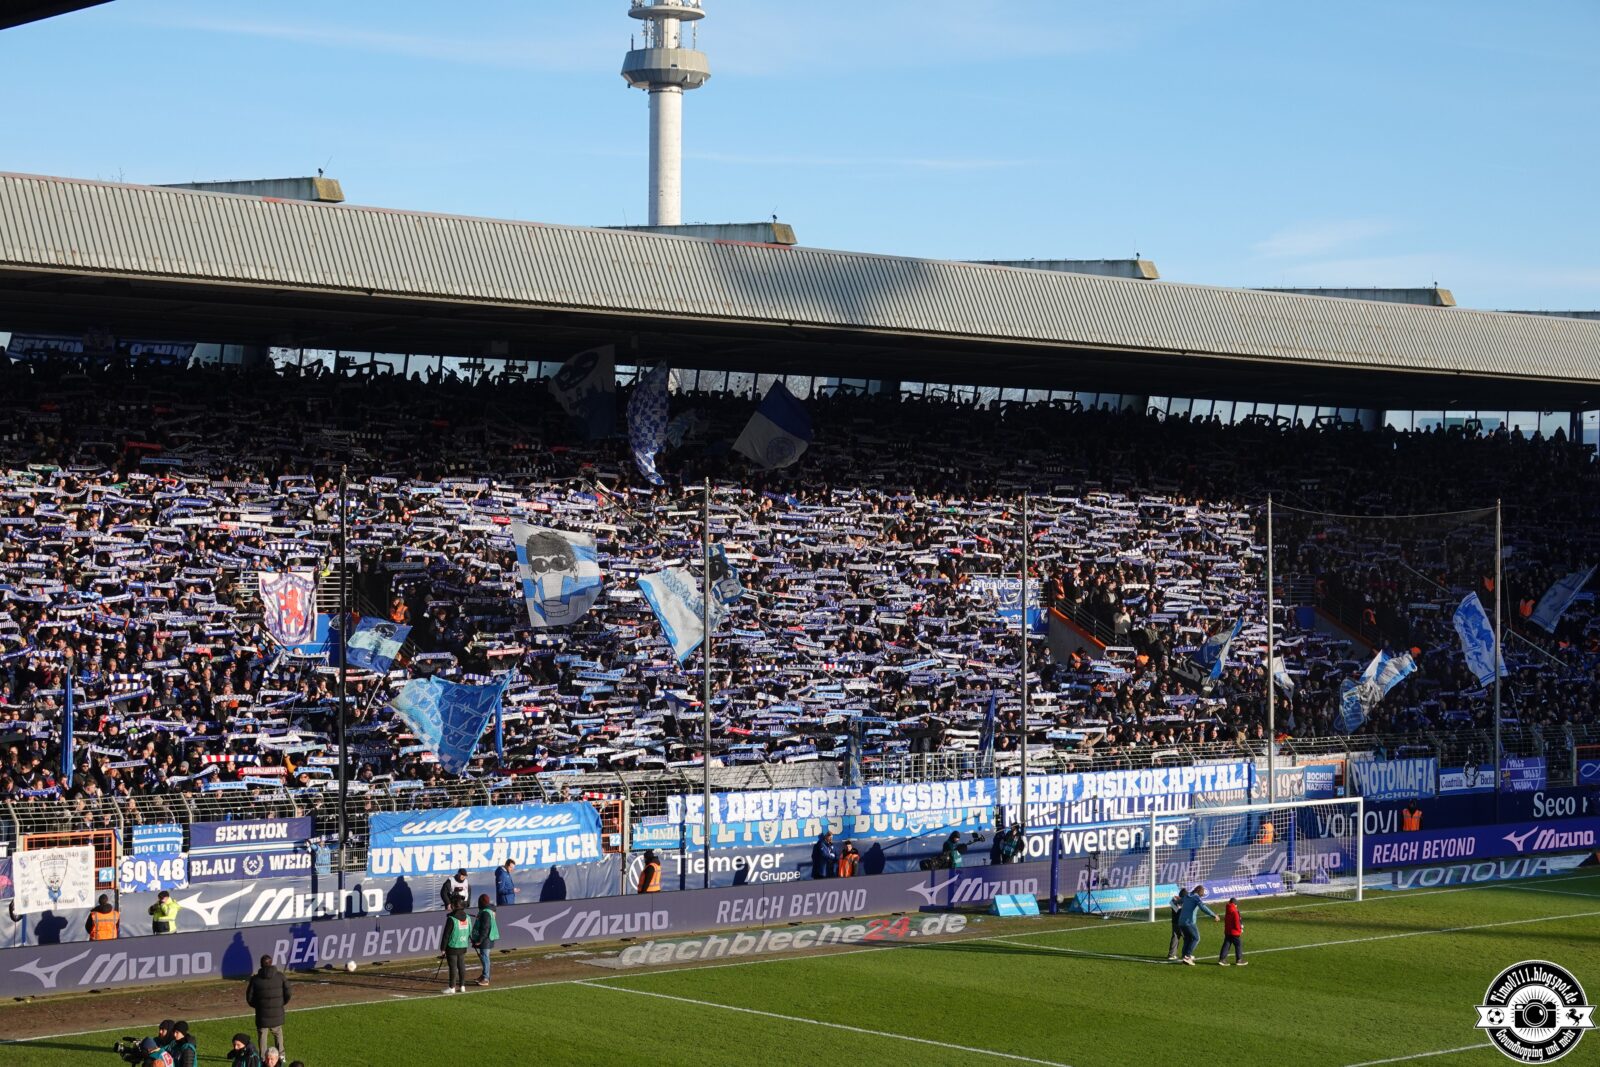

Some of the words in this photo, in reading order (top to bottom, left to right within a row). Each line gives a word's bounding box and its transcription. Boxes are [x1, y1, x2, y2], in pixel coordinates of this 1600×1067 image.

[1000, 775, 1078, 804] BLEIBT
[1082, 763, 1248, 800] RISIKOKAPITAL!
[1306, 772, 1333, 780] BOCHUM
[1306, 783, 1333, 791] NAZIFREI
[668, 794, 721, 824] DER
[727, 788, 862, 822] DEUTSCHE
[869, 780, 991, 814] FUSSBALL
[1533, 791, 1576, 818] Seco
[134, 827, 153, 836] BLUE
[154, 824, 182, 834] SYSTEM
[216, 823, 288, 843] SEKTION
[402, 809, 574, 836] unbequem
[134, 843, 182, 855] BOCHUM
[372, 832, 598, 874] UNVERKÄUFLICH
[610, 835, 621, 846] 22
[1372, 842, 1419, 864] REACH
[1422, 837, 1475, 860] BEYOND
[101, 870, 113, 880] 21
[122, 861, 147, 884] SQ
[159, 858, 186, 881] 48
[191, 858, 236, 877] BLAU
[671, 851, 784, 882] Tiemeyer
[760, 870, 800, 883] Gruppe
[716, 894, 786, 924] REACH
[789, 888, 867, 918] BEYOND
[273, 932, 354, 966] REACH
[363, 926, 443, 957] BEYON
[618, 912, 967, 968] dachbleche24.de
